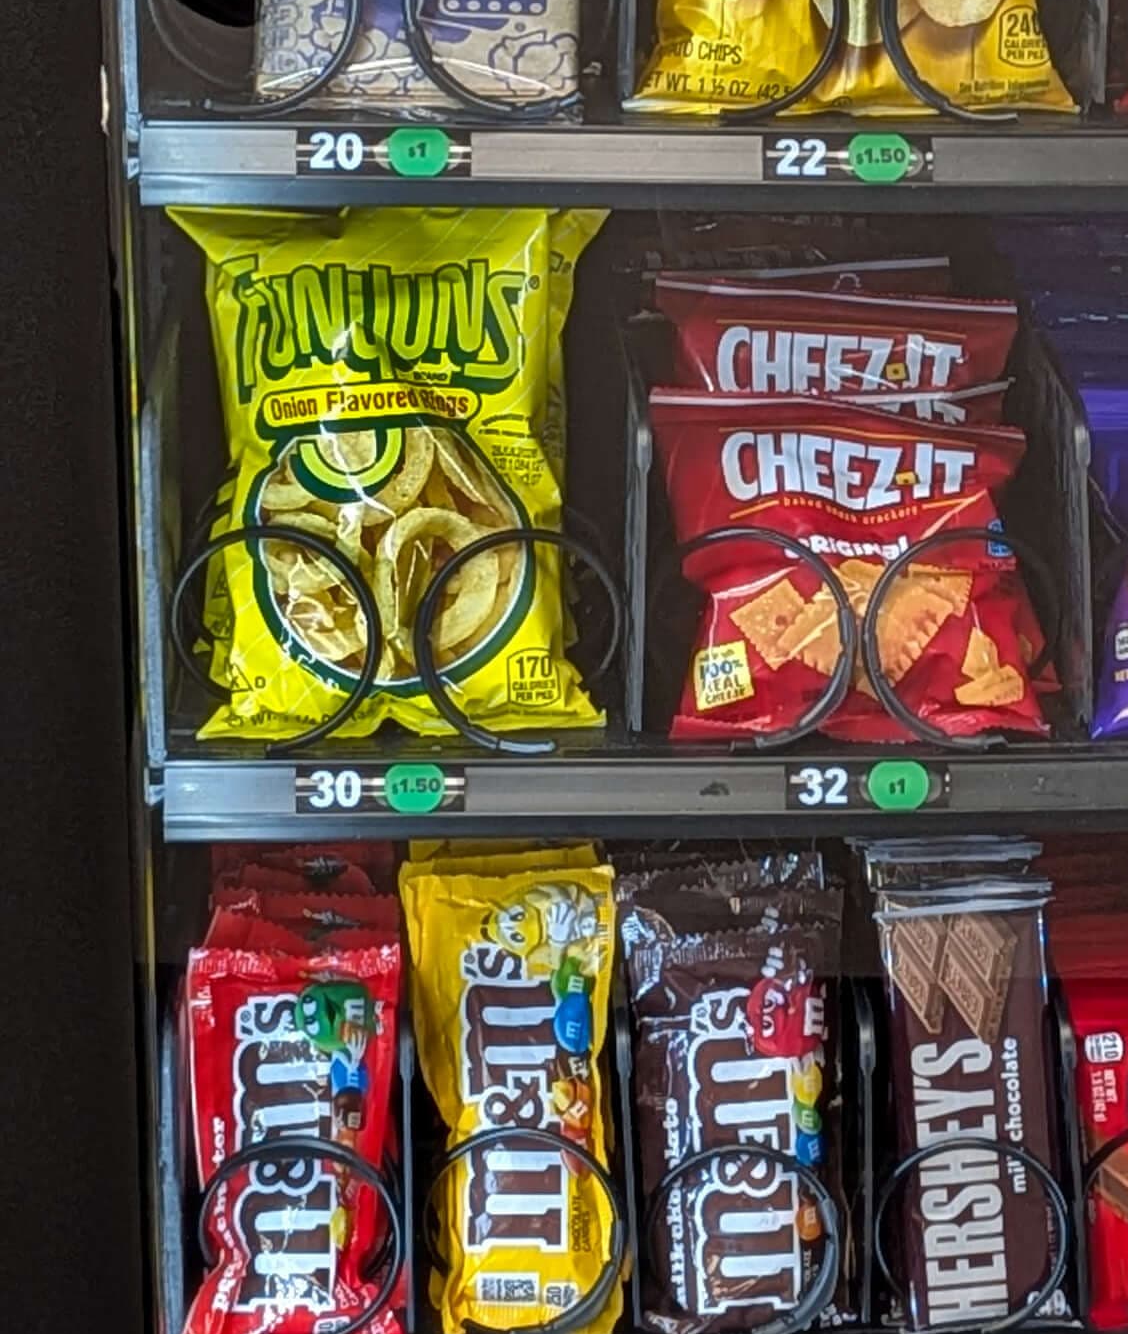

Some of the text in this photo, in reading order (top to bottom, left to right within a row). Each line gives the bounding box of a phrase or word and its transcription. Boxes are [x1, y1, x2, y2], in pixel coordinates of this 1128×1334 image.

[698, 40, 743, 65] CHIPS
[309, 133, 363, 170] 20
[408, 142, 427, 159] $1
[775, 138, 828, 176] 22
[856, 149, 907, 165] $1.50
[222, 255, 528, 400] FUNYUNS
[271, 395, 318, 421] Onion
[326, 387, 419, 414] Flavored
[783, 497, 822, 509] baked
[515, 654, 553, 679] 170
[309, 770, 362, 808] 30
[391, 777, 441, 794] $1.50
[798, 767, 849, 805] 32
[888, 777, 907, 794] $1
[1103, 1034, 1118, 1060] 210
[1001, 1036, 1023, 1142] chocolate
[910, 1037, 1008, 1325] HERSHEY'S
